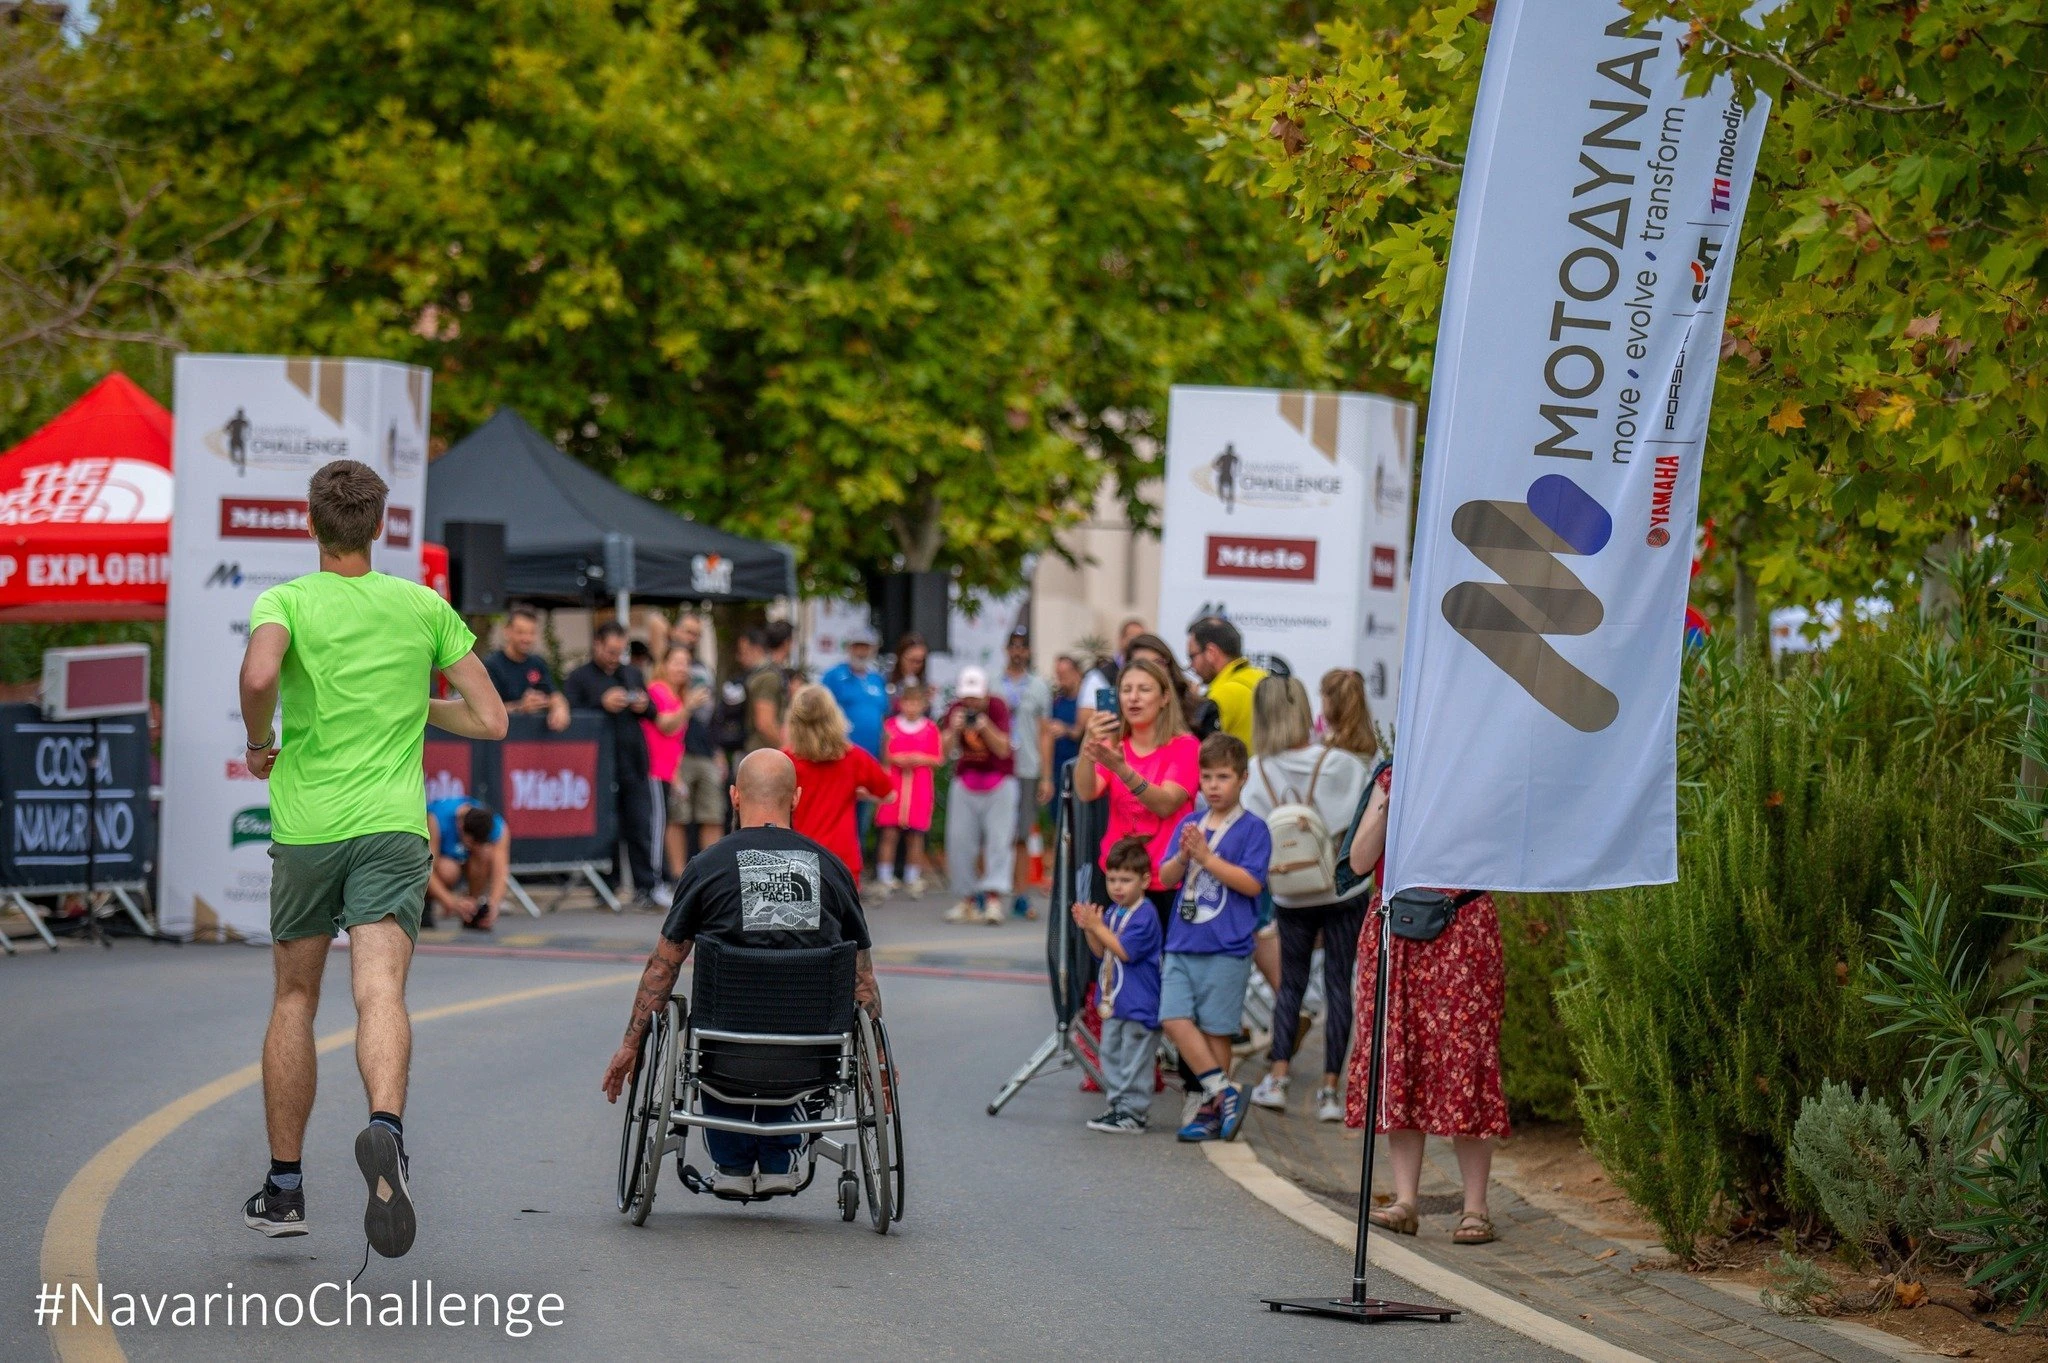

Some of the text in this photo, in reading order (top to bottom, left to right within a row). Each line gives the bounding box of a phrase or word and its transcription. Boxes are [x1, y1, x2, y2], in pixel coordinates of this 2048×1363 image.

[1612, 107, 1685, 464] move evolve transform
[1650, 456, 1679, 528] YAMAHA
[1217, 546, 1307, 570] Miele
[14, 802, 135, 852] NAVARNO
[750, 881, 791, 892] NORTH
[767, 872, 790, 882] THE
[762, 892, 791, 902] FACE
